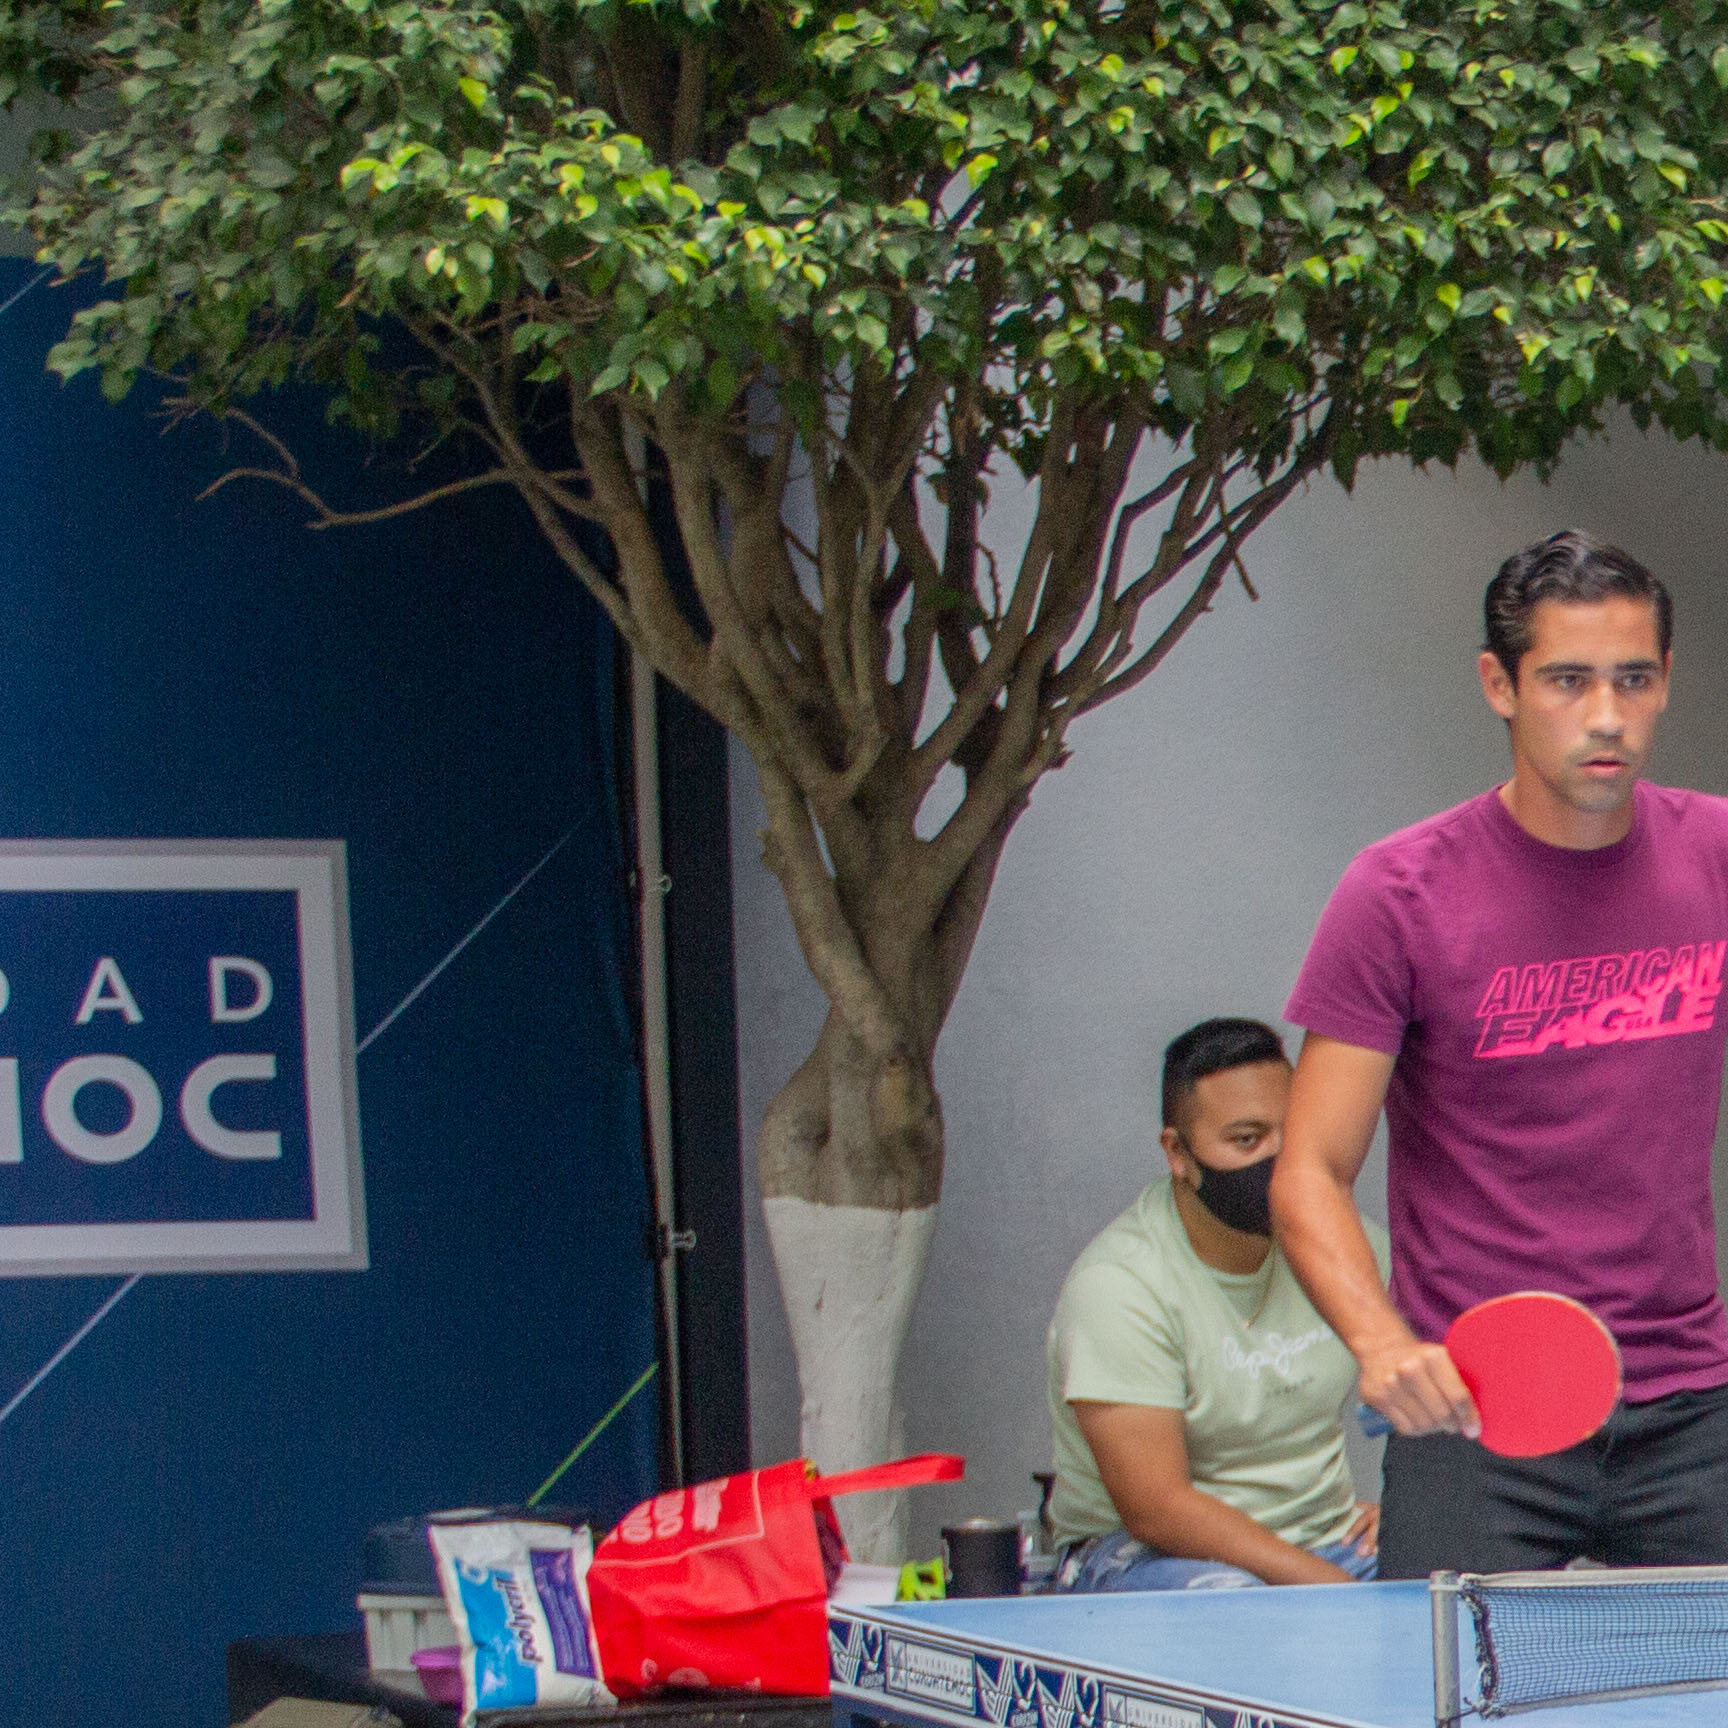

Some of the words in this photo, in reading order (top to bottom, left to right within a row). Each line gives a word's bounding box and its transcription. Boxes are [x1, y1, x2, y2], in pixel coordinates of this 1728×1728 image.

[0, 954, 274, 1026] AD
[1474, 940, 1728, 1019] AMERICAN
[1472, 983, 1723, 1059] EAGLE
[0, 1052, 283, 1165] OC
[495, 1574, 543, 1664] polycril
